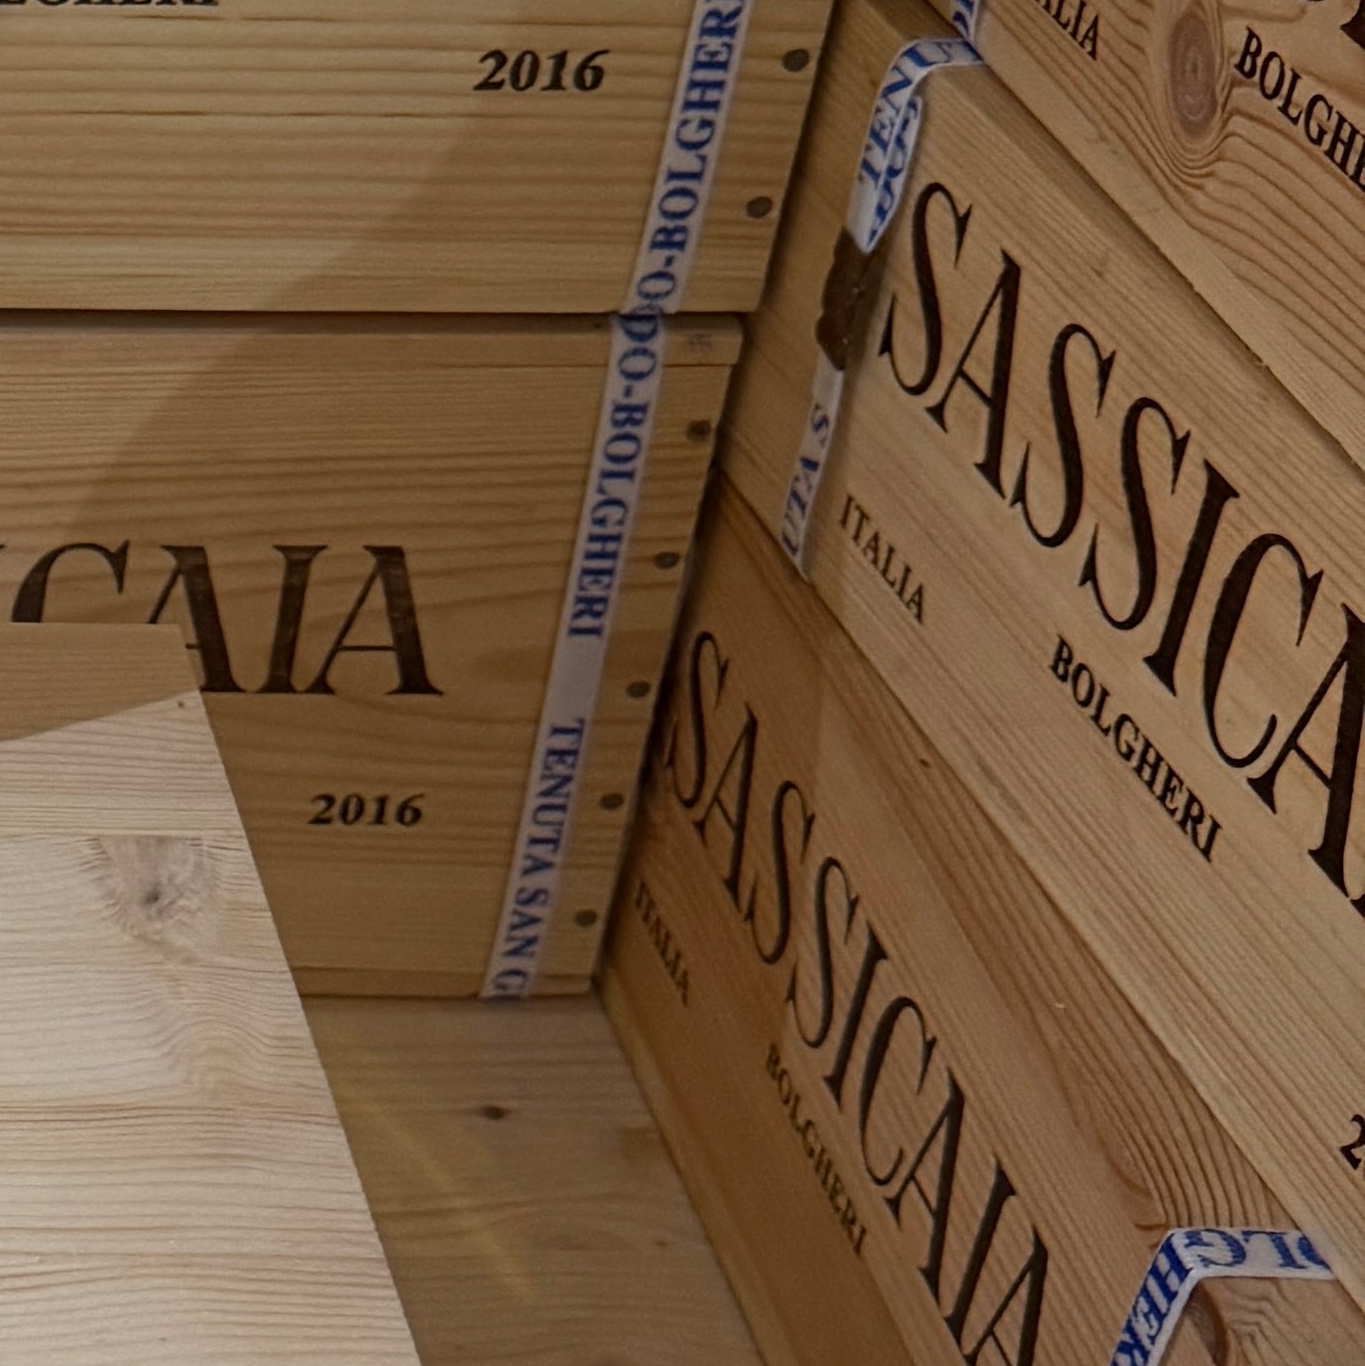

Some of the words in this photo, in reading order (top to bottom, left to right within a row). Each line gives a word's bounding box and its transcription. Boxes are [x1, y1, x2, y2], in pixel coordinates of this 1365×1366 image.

[473, 49, 610, 92] 2016
[839, 494, 926, 625] ITALIA
[878, 182, 1365, 917] SASSICA
[308, 795, 425, 826] 2016
[522, 717, 585, 877] TENUTA
[1049, 634, 1222, 863] BOLGHERI
[766, 1043, 869, 1258] BOLGHERI
